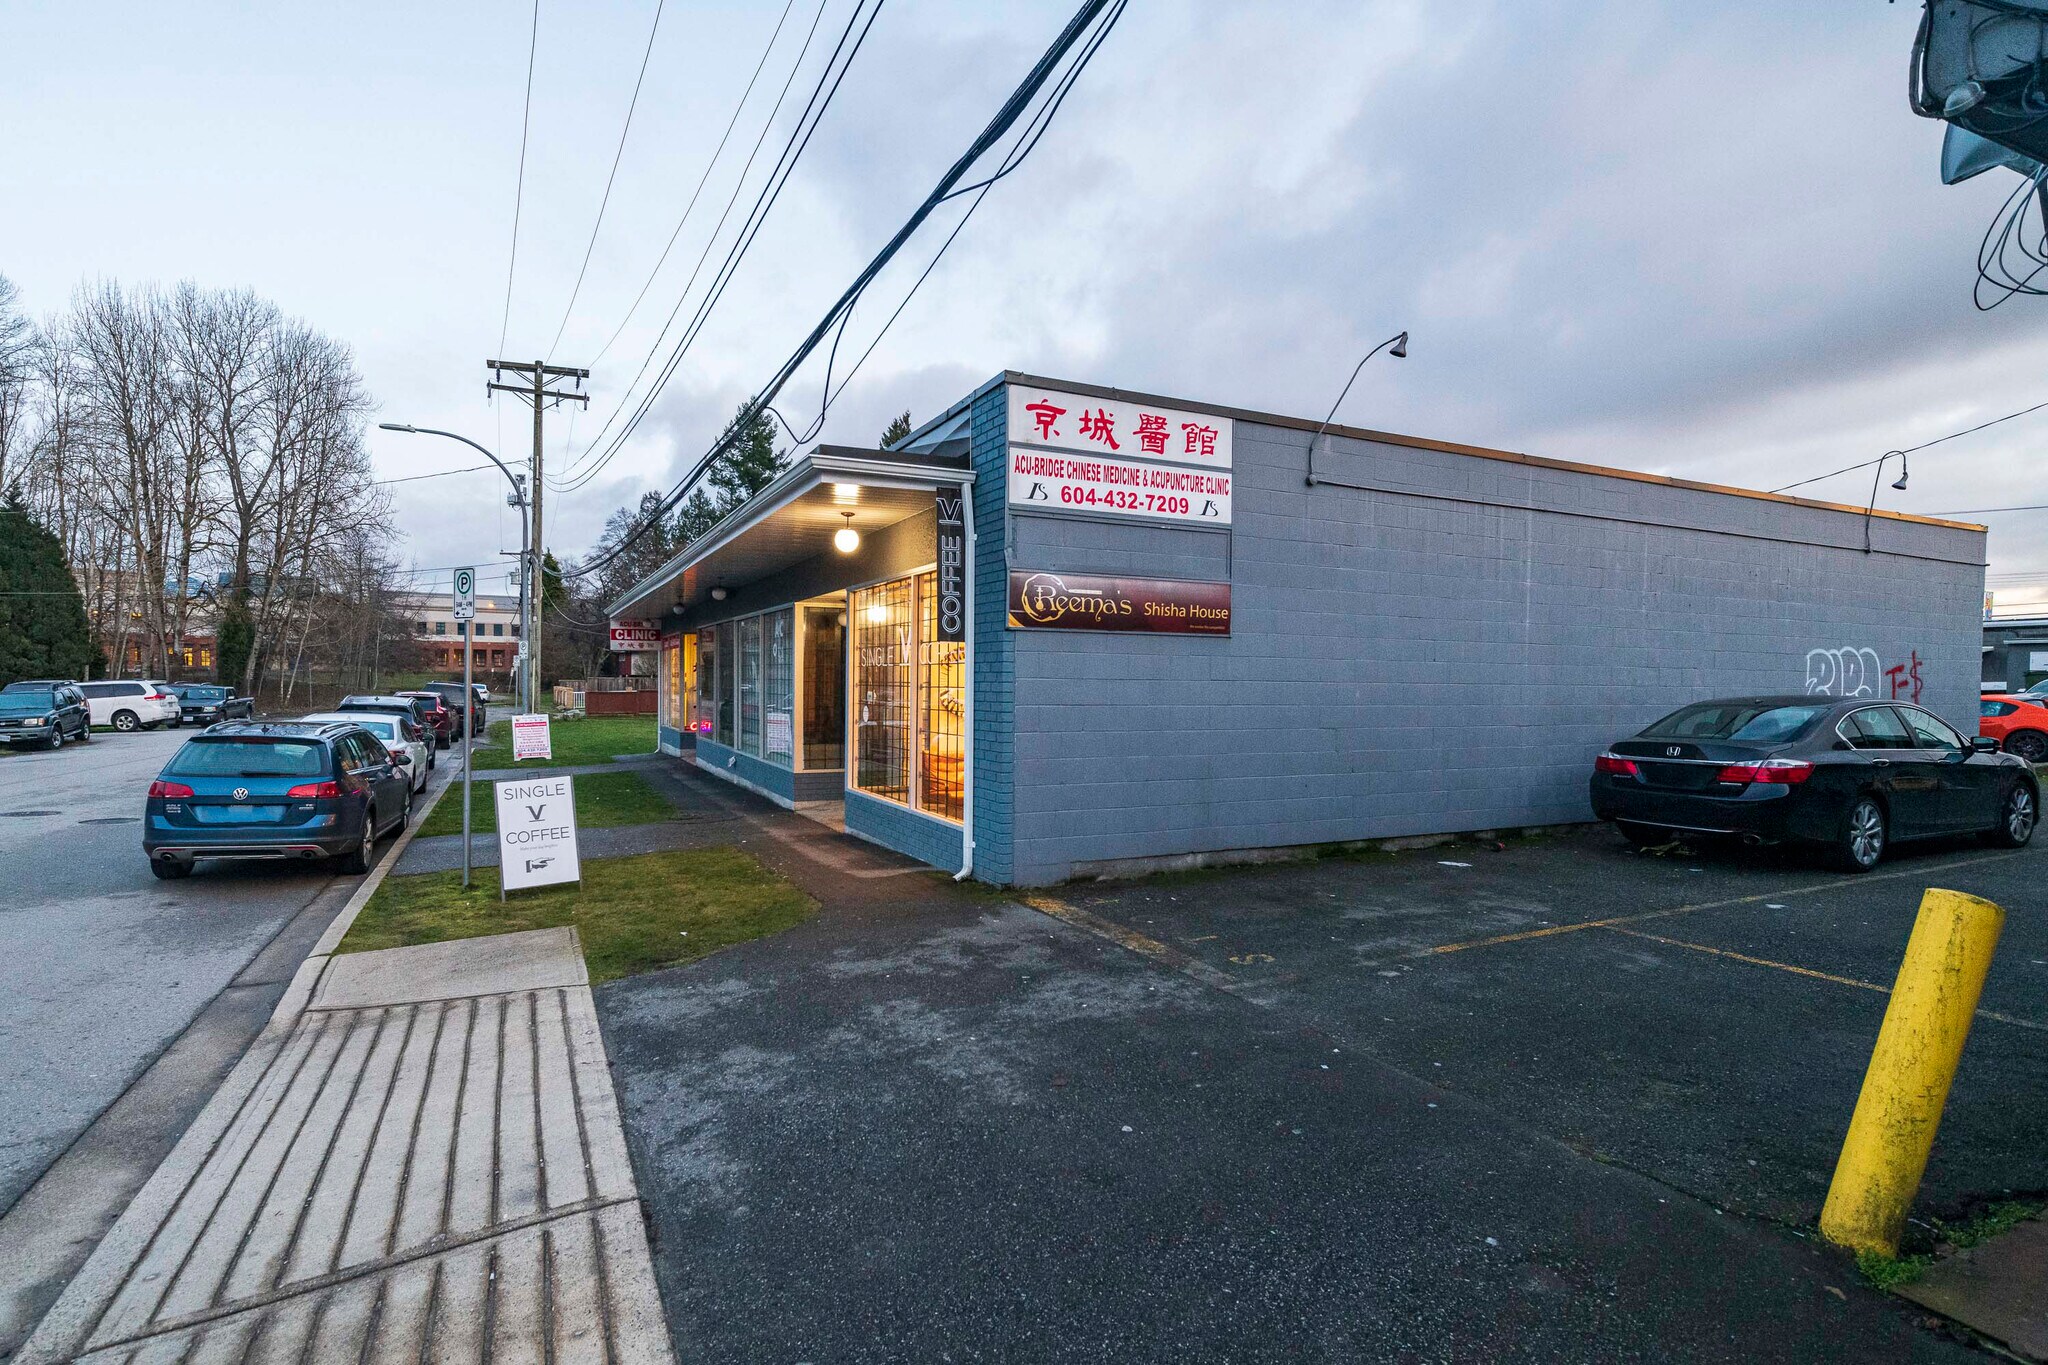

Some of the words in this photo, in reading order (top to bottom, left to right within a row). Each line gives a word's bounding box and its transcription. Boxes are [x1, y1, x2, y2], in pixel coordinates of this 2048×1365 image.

[1025, 398, 1219, 455] 京城醫館
[1014, 454, 1064, 479] ACU-BRIDGE
[1066, 461, 1101, 482] CHINESE
[1103, 465, 1140, 487] MEDICINE
[1142, 472, 1148, 487] &
[1150, 470, 1204, 493] ACUPUNCTURE
[1205, 475, 1230, 496] CLINIC
[1060, 485, 1189, 515] 604-432-7209
[941, 535, 962, 634] COFFEE
[1144, 602, 1186, 617] Shisha
[1189, 604, 1229, 620] House
[615, 629, 657, 640] CLINIC
[861, 645, 894, 667] SINGLE
[503, 783, 565, 801] SINGLE
[525, 803, 547, 823] V
[506, 826, 570, 845] COFFEE
